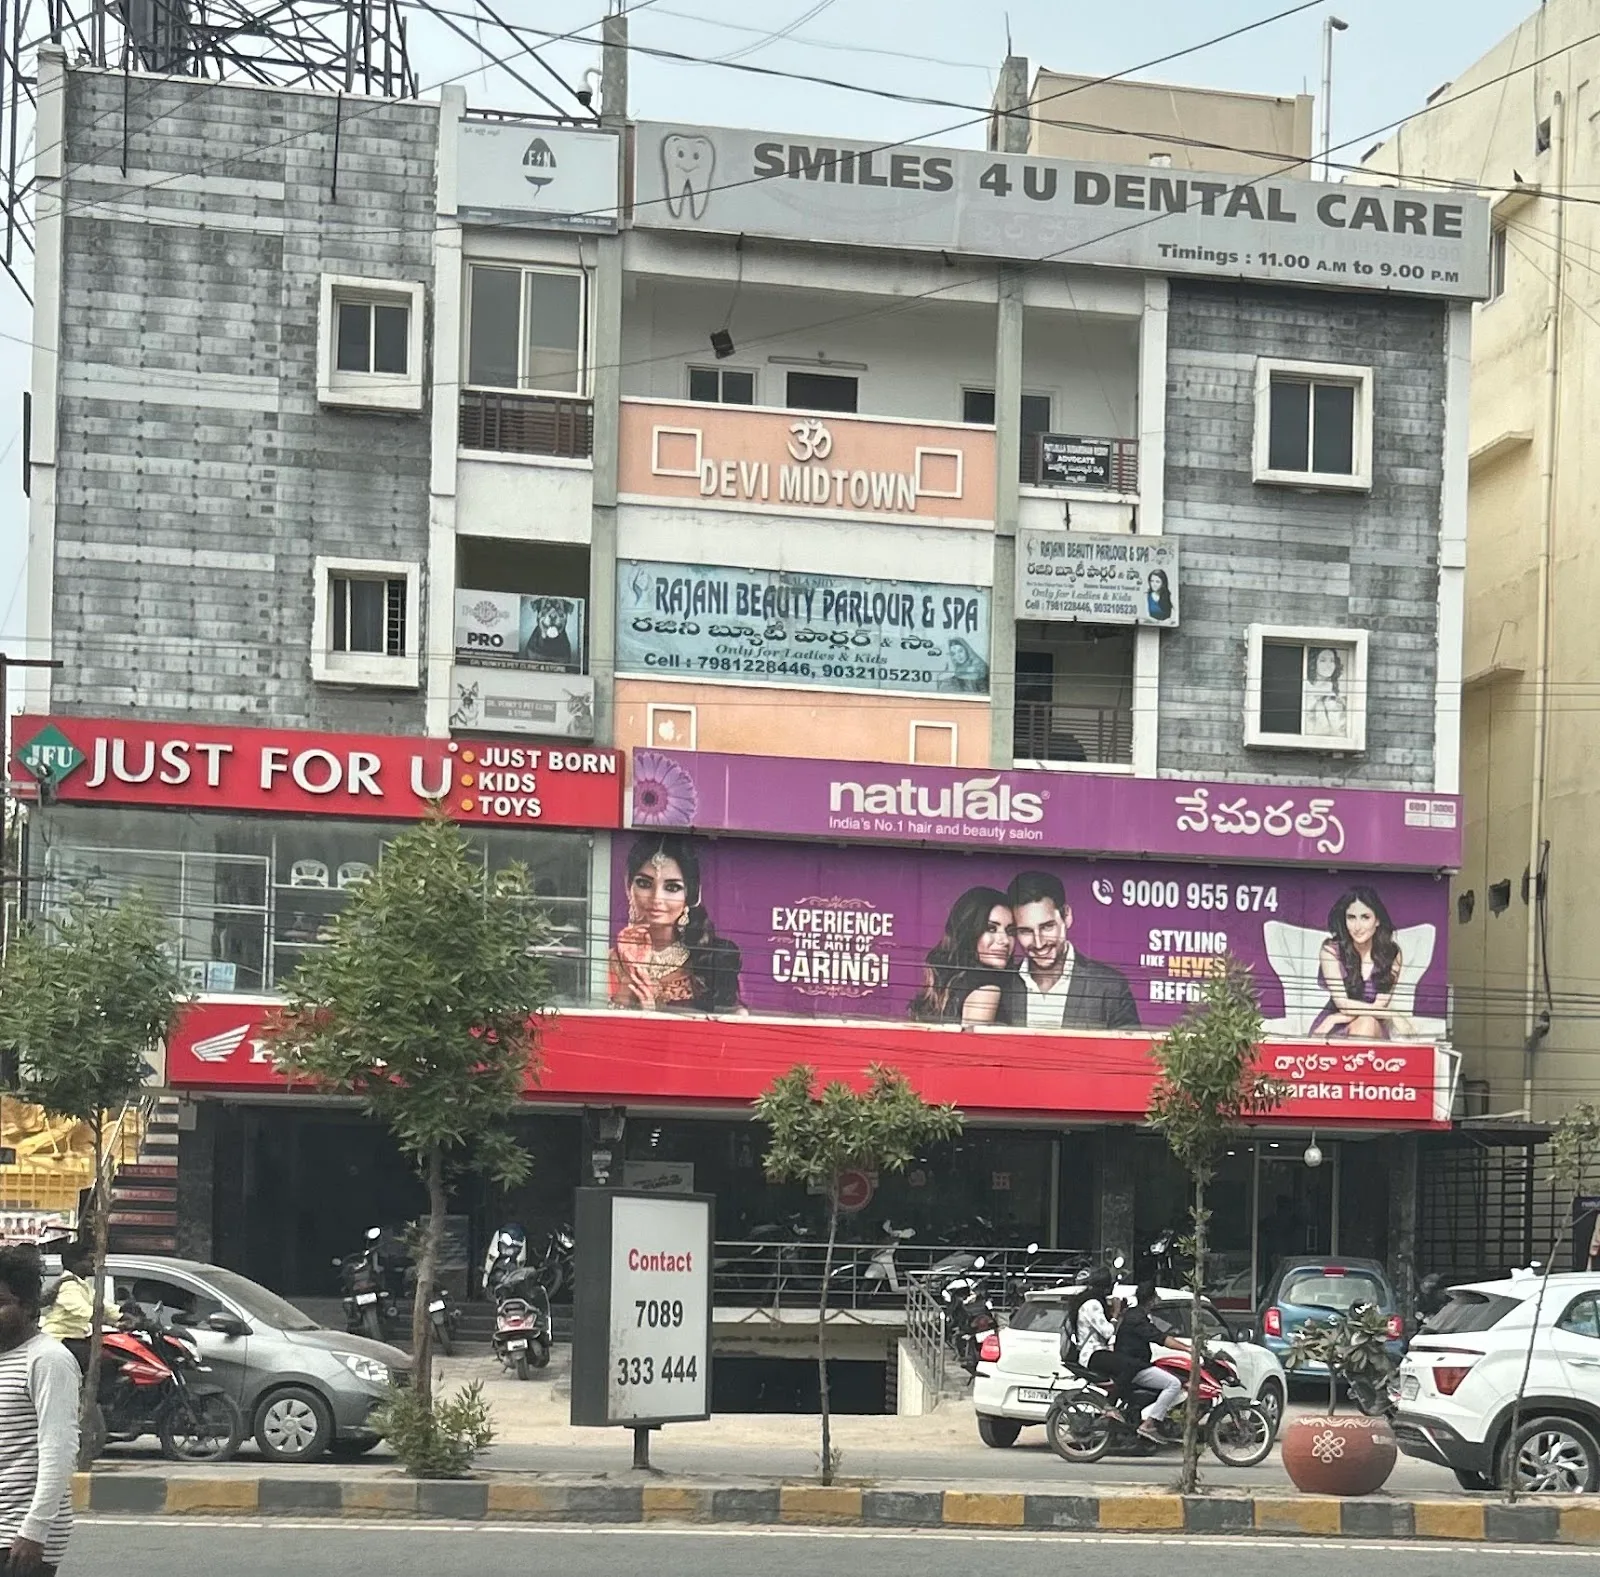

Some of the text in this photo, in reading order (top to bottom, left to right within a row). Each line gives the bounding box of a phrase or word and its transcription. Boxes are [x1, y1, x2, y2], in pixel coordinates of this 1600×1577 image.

[753, 142, 1463, 239] SMILES 4 U DENTAL CARE
[1158, 243, 1238, 266] Timings
[1258, 251, 1310, 270] 11.00
[1317, 259, 1347, 273] A.M
[1353, 259, 1373, 276] to
[1380, 263, 1424, 280] 9.00
[1431, 269, 1458, 283] P.M
[700, 457, 916, 512] DEVI MIDTOWN
[656, 577, 978, 633] RAJANI BEAUTY PARLOUR & SPA
[467, 632, 504, 647] PRO
[880, 637, 893, 648] &
[715, 644, 888, 665] Only for Ladies & Kids
[644, 653, 680, 668] Cell
[822, 663, 932, 683] 9032105230
[26, 744, 74, 768] JFU
[85, 737, 451, 799] JUST FOR U
[479, 747, 617, 774] JUST BORN
[478, 772, 536, 793] KIDS
[478, 796, 542, 818] TOYS
[829, 774, 1044, 824] naturals
[828, 816, 1043, 841] India's No.1 hair and beauty salon
[1122, 879, 1279, 913] 9000 955 674
[772, 907, 894, 937] EXPERIENCE
[793, 931, 874, 953] THE ART OF
[1149, 928, 1228, 954] STYLING
[772, 949, 889, 988] CARING!
[1140, 953, 1165, 968] LIKE
[1149, 980, 1211, 1004] BEFO
[1349, 1081, 1417, 1101] Honda
[628, 1248, 693, 1272] Contact
[635, 1300, 683, 1328] 7089
[617, 1355, 697, 1386] 333 444
